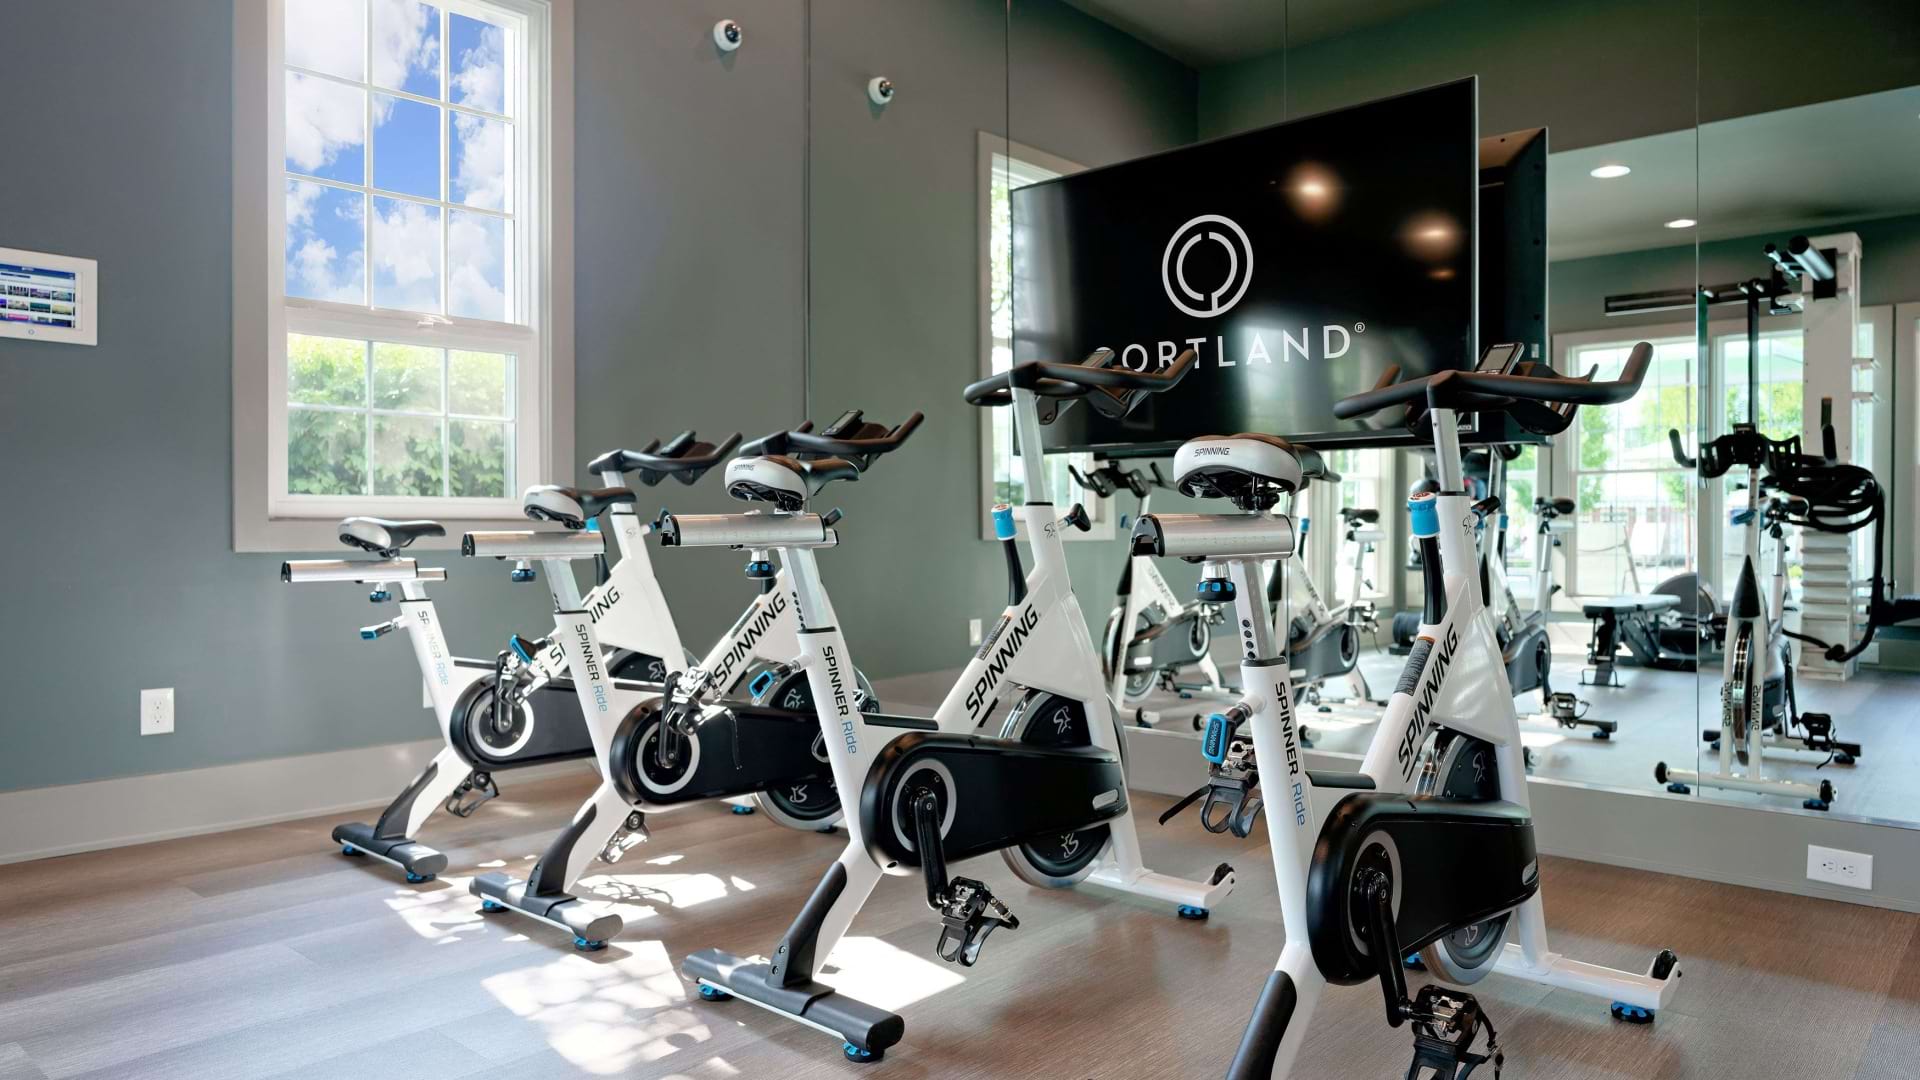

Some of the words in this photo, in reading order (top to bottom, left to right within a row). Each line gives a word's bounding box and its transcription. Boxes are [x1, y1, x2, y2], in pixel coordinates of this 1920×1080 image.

[1193, 447, 1231, 458] SPINNING
[575, 624, 600, 680] SPINNER
[593, 684, 608, 713] Ride
[714, 592, 786, 687] SPINNING
[965, 603, 1039, 721] SPINNING
[822, 645, 850, 717] SPINNER
[841, 720, 857, 754] Ride
[1275, 681, 1300, 777] SPINNER
[1291, 782, 1306, 827] Ride
[1398, 623, 1459, 777] SPINNING
